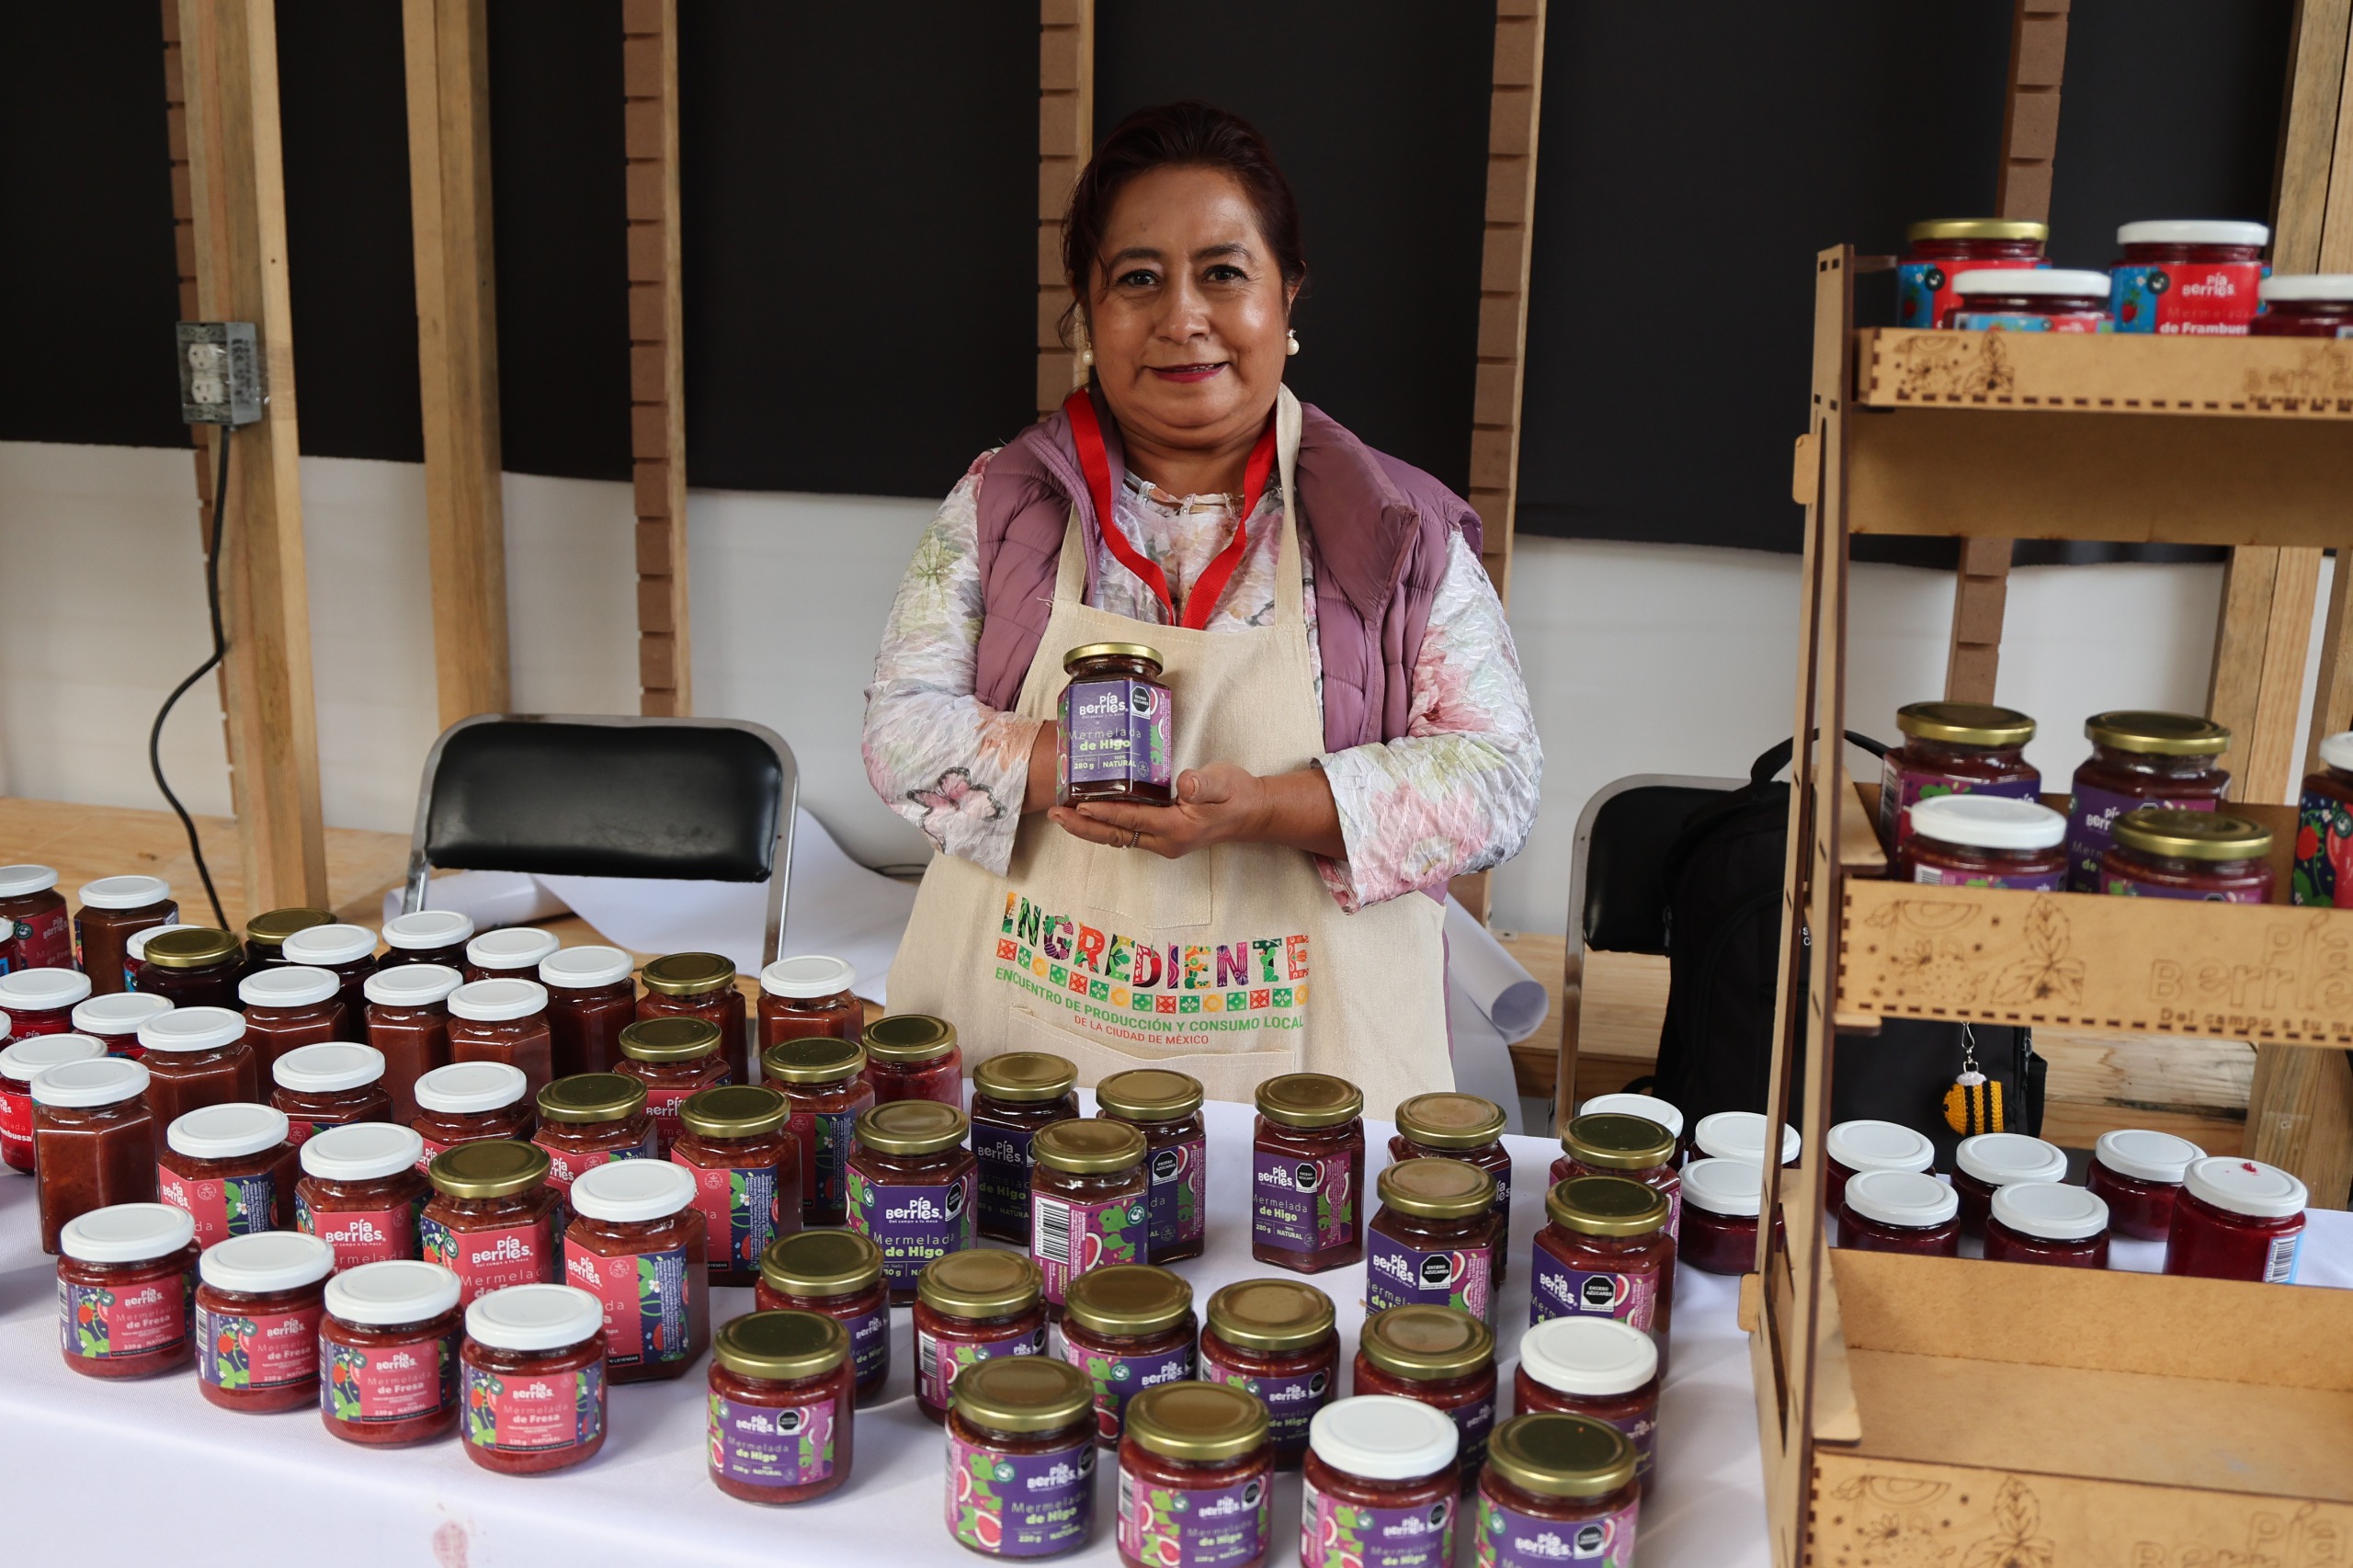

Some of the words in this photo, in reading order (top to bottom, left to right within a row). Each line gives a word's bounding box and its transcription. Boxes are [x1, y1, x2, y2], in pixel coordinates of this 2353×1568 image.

[2159, 322, 2179, 334] de
[1099, 692, 1118, 705] Pía
[1079, 700, 1126, 716] Berries
[1069, 727, 1142, 740] Mermelada
[1079, 741, 1097, 751] de
[1099, 738, 1131, 750] Higo
[1102, 760, 1137, 768] NATURAL
[1001, 891, 1310, 991] INGREDIENTE
[995, 966, 1063, 1006] ENCUENTRO
[1064, 997, 1083, 1014] DE
[1085, 1003, 1173, 1032] PRODUCCIÓN
[1176, 1020, 1186, 1032] Y
[1189, 1017, 1260, 1032] CONSUMO
[1263, 1014, 1304, 1030] LOCAL
[2161, 1007, 2195, 1021] Del
[2205, 1012, 2272, 1030] campo
[2282, 1018, 2291, 1028] a
[2302, 1018, 2322, 1031] tu
[1074, 1015, 1088, 1027] DE
[1090, 1019, 1104, 1032] LA
[1106, 1024, 1146, 1042] CIUDAD
[1148, 1032, 1162, 1044] DE
[1165, 1031, 1210, 1045] MÉXICO
[996, 1141, 1013, 1153] Pía
[978, 1146, 1021, 1163] Berries
[552, 1157, 568, 1172] Pía
[1273, 1165, 1287, 1177] Pía
[1258, 1172, 1292, 1187] Berries
[172, 1182, 184, 1196] Pía
[979, 1183, 993, 1192] de
[997, 1186, 1027, 1199] Higo
[163, 1185, 189, 1209] Berries
[909, 1197, 931, 1210] Pía
[886, 1208, 939, 1220] Berries
[1259, 1206, 1272, 1216] de
[1274, 1209, 1298, 1221] Higo
[349, 1219, 372, 1232] Pía
[325, 1230, 383, 1243] Berries
[873, 1232, 955, 1244] Mermelada
[1277, 1230, 1303, 1240] NATURAL
[497, 1235, 520, 1251] Pía
[472, 1244, 530, 1265] Berries
[885, 1246, 904, 1257] de
[908, 1245, 945, 1259] Higo
[580, 1257, 594, 1272] Pía
[1373, 1255, 1415, 1283] Berries
[1391, 1254, 1408, 1272] Pía
[568, 1259, 601, 1285] Berries
[125, 1291, 164, 1306] Berries
[141, 1287, 156, 1297] Pía
[1371, 1295, 1386, 1309] de
[126, 1320, 141, 1329] de
[142, 1314, 170, 1326] Fresa
[267, 1351, 282, 1360] de
[284, 1346, 311, 1358] Fresa
[392, 1352, 409, 1362] Pía
[614, 1355, 639, 1363] LEYENDAS
[376, 1358, 416, 1370] Berries
[378, 1384, 392, 1394] de
[394, 1382, 424, 1392] Fresa
[503, 1403, 568, 1415] Mermelada
[513, 1415, 528, 1424] de
[529, 1415, 560, 1423] Fresa
[736, 1449, 749, 1459] de
[750, 1451, 778, 1463] Higo
[1026, 1514, 1045, 1524] de
[1047, 1506, 1077, 1522] Higo
